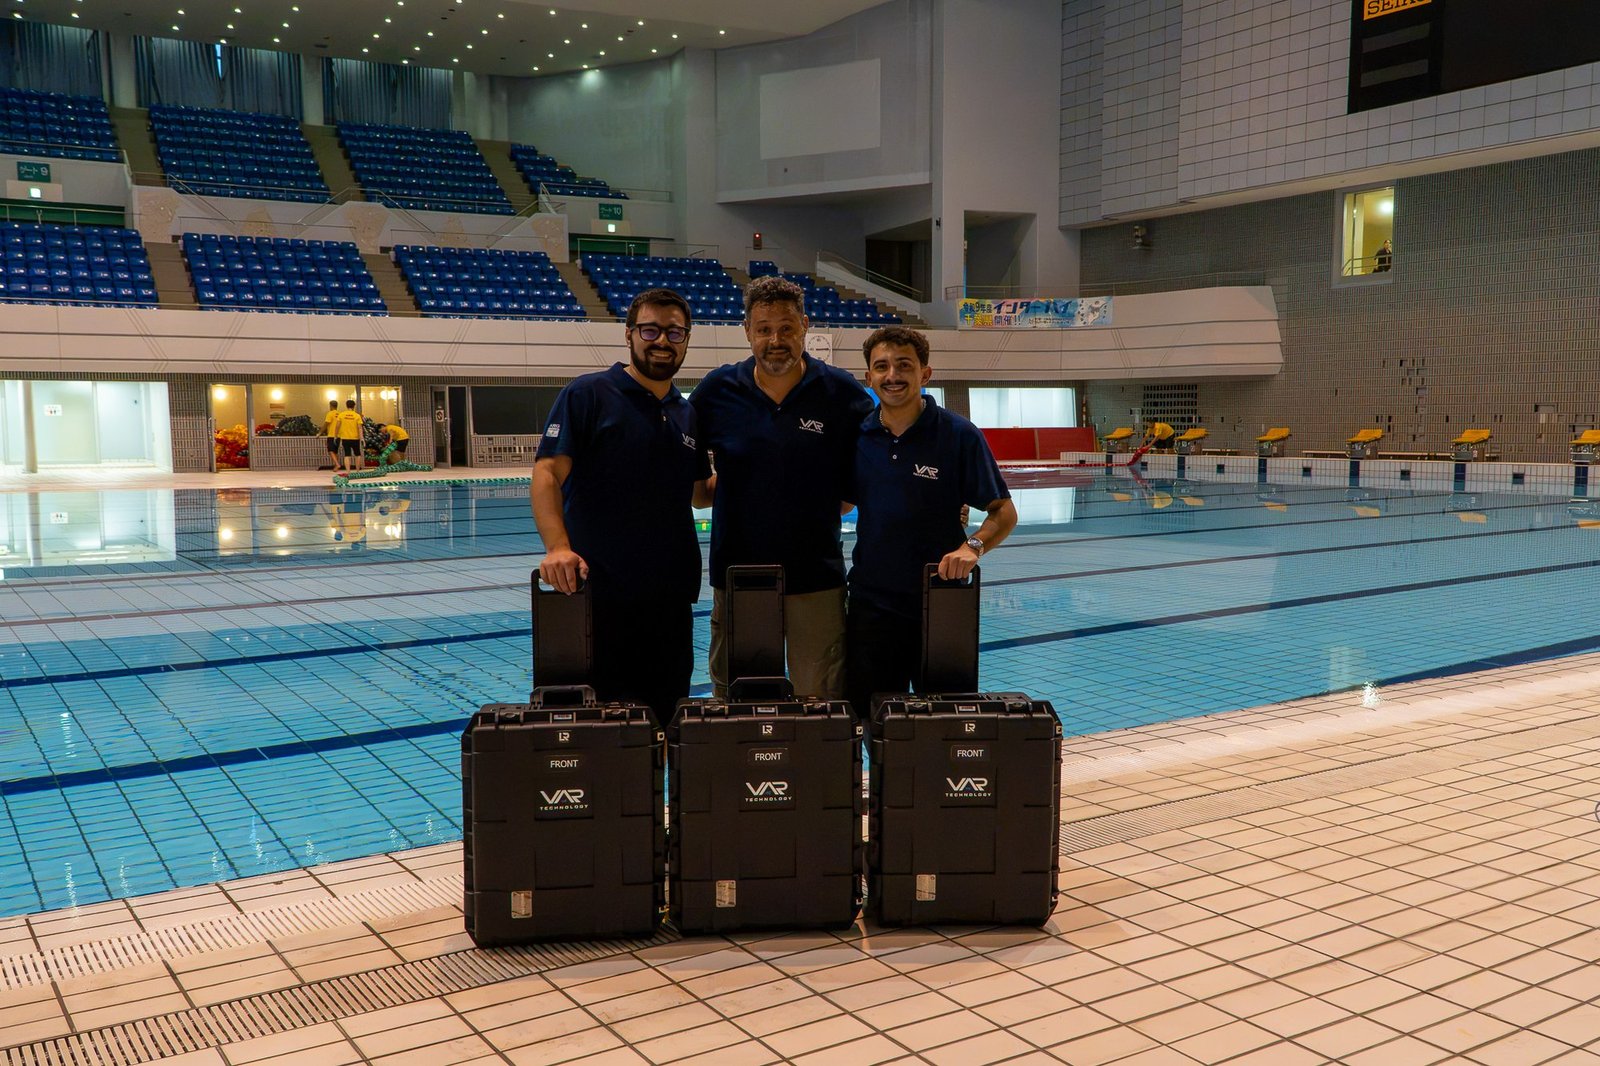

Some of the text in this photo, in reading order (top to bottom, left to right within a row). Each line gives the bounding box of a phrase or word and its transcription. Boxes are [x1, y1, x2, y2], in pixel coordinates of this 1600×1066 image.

[1367, 0, 1425, 16] SEI
[40, 166, 49, 176] 9
[800, 417, 824, 431] VAR
[914, 463, 939, 477] VAR
[754, 752, 782, 761] FRONT
[956, 749, 985, 758] FRONT
[550, 759, 579, 768] FRONT
[745, 781, 788, 796] VAR
[945, 777, 988, 791] VAR
[539, 789, 585, 804] VAR
